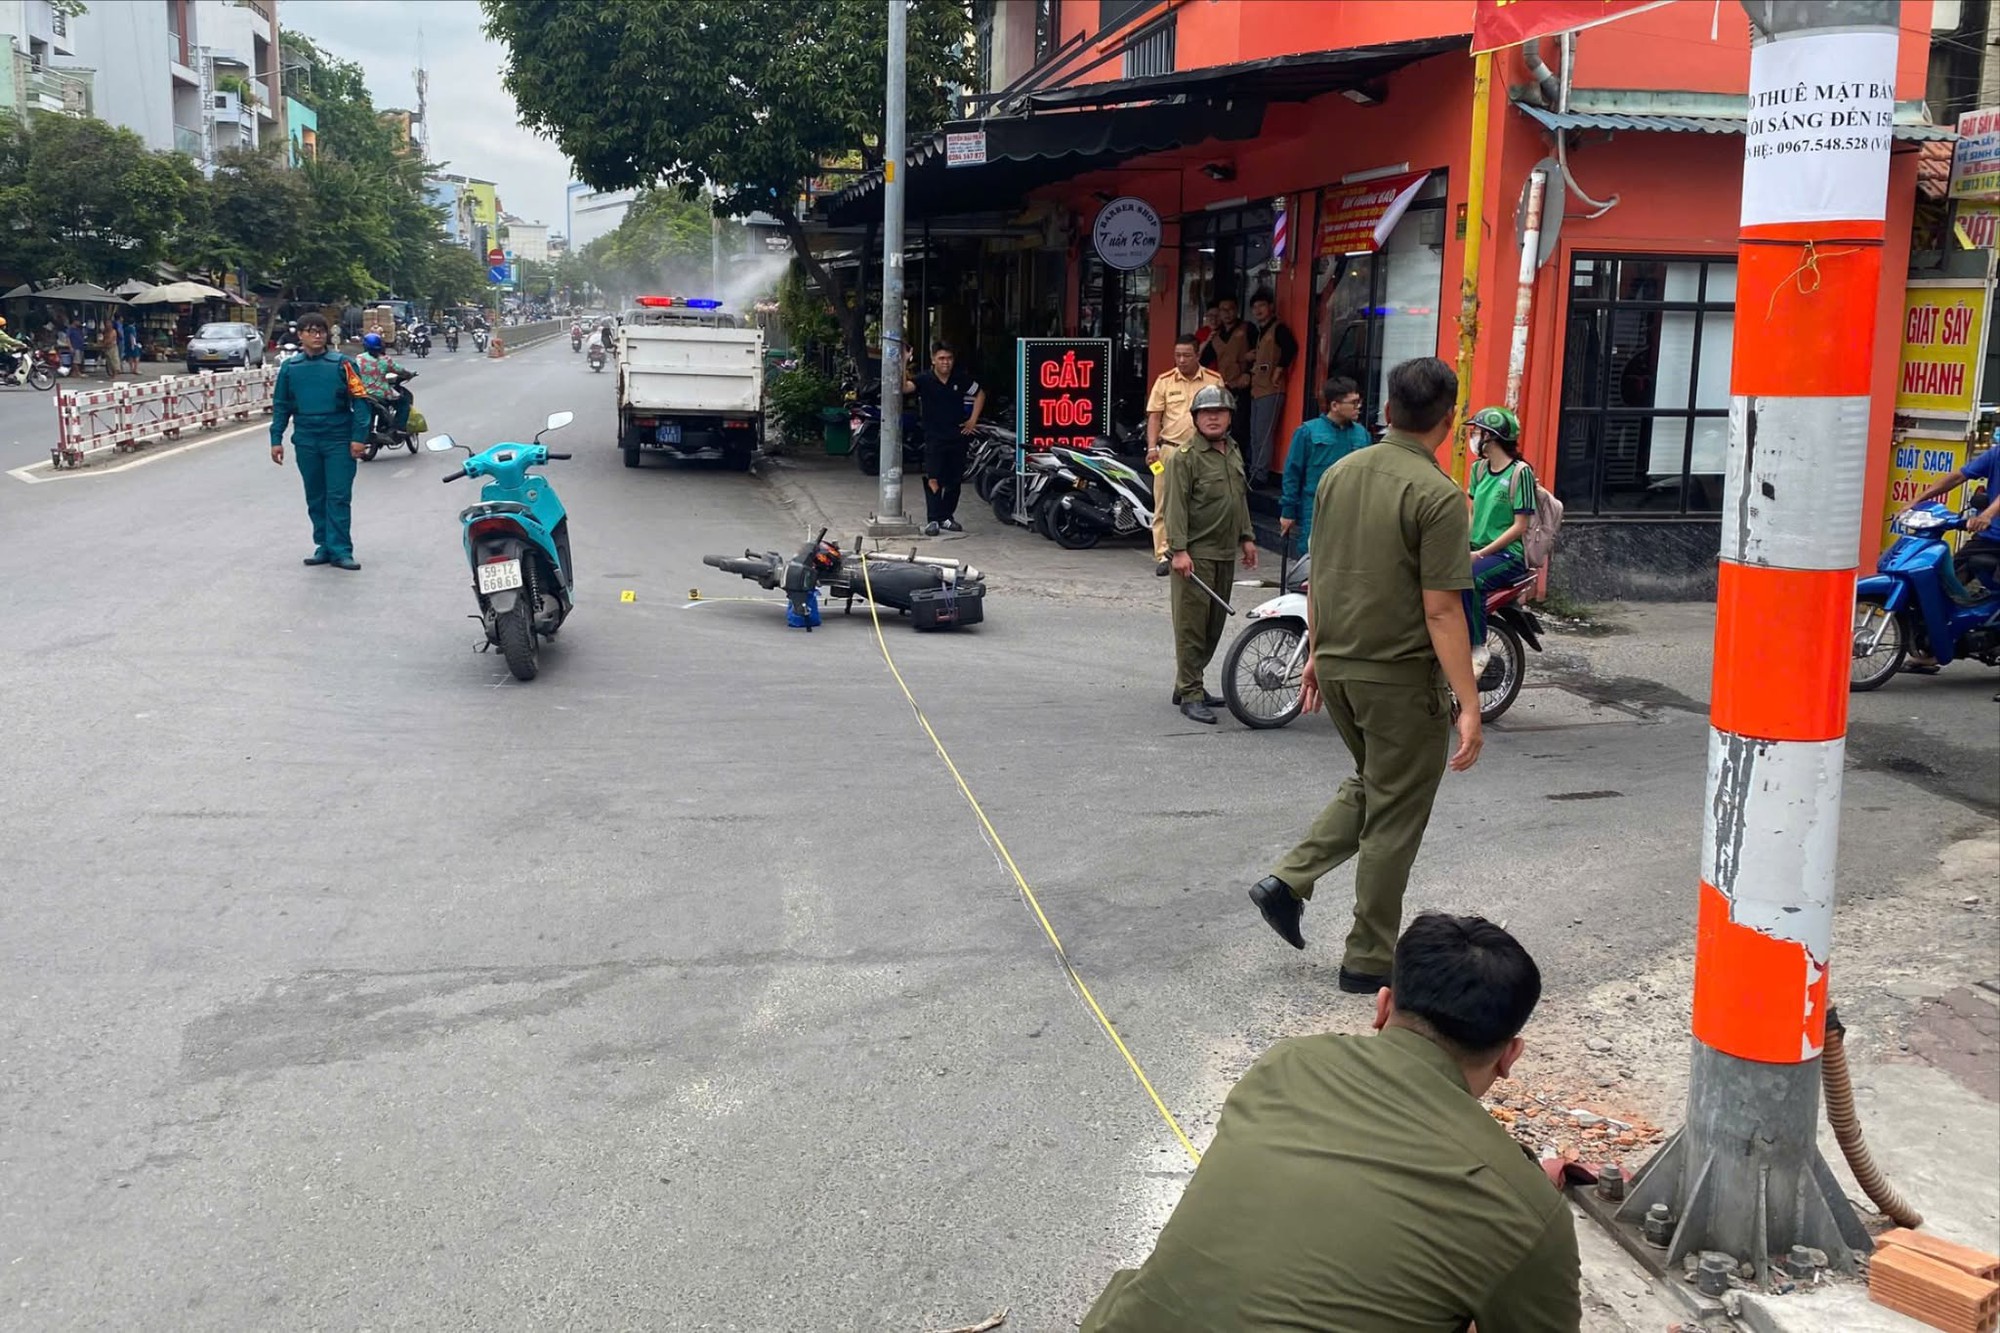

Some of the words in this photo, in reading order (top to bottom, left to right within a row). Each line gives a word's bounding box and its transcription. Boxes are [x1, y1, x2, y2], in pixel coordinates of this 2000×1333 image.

[1758, 82, 1807, 108] THUÊ
[1815, 81, 1865, 103] MẶT
[1767, 111, 1823, 133] SÁNG
[1830, 106, 1871, 127] ĐẾN
[1777, 137, 1868, 155] 0967.548.528
[1100, 204, 1134, 229] BARBER
[1137, 206, 1157, 227] SHOP
[1906, 304, 1940, 349] GIẶT
[1942, 300, 1974, 345] SẤY
[1041, 350, 1094, 388] CẮT
[1903, 361, 1965, 395] NHANH
[1040, 393, 1092, 426] TÓC
[1896, 445, 1920, 474] GIẶT
[1923, 450, 1953, 475] SẠCH
[1892, 474, 1918, 501] SẤY
